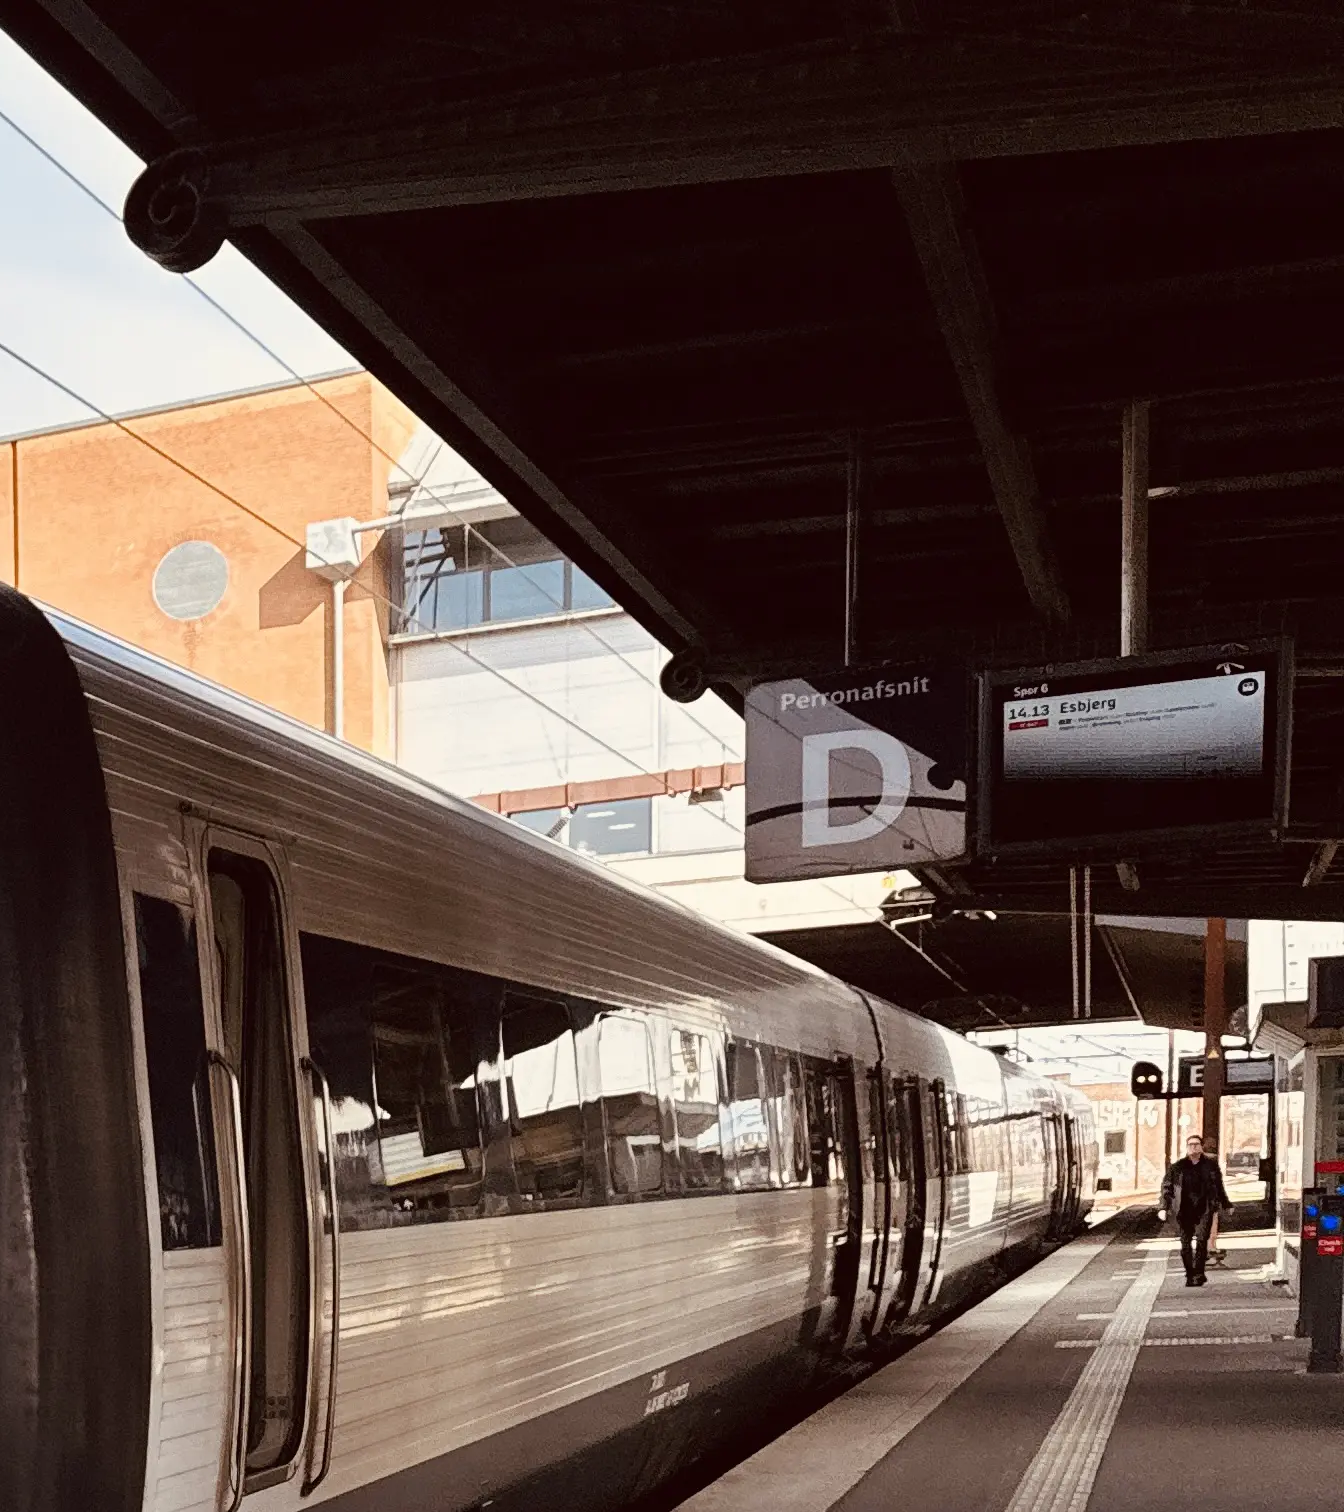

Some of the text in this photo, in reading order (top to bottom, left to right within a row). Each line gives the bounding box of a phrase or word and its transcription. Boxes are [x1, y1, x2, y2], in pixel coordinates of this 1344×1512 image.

[780, 676, 930, 711] Perronafsnit
[1013, 686, 1039, 698] Spor
[1009, 704, 1050, 720] 14.13
[1060, 698, 1116, 714] Esbjerg
[802, 729, 911, 849] D
